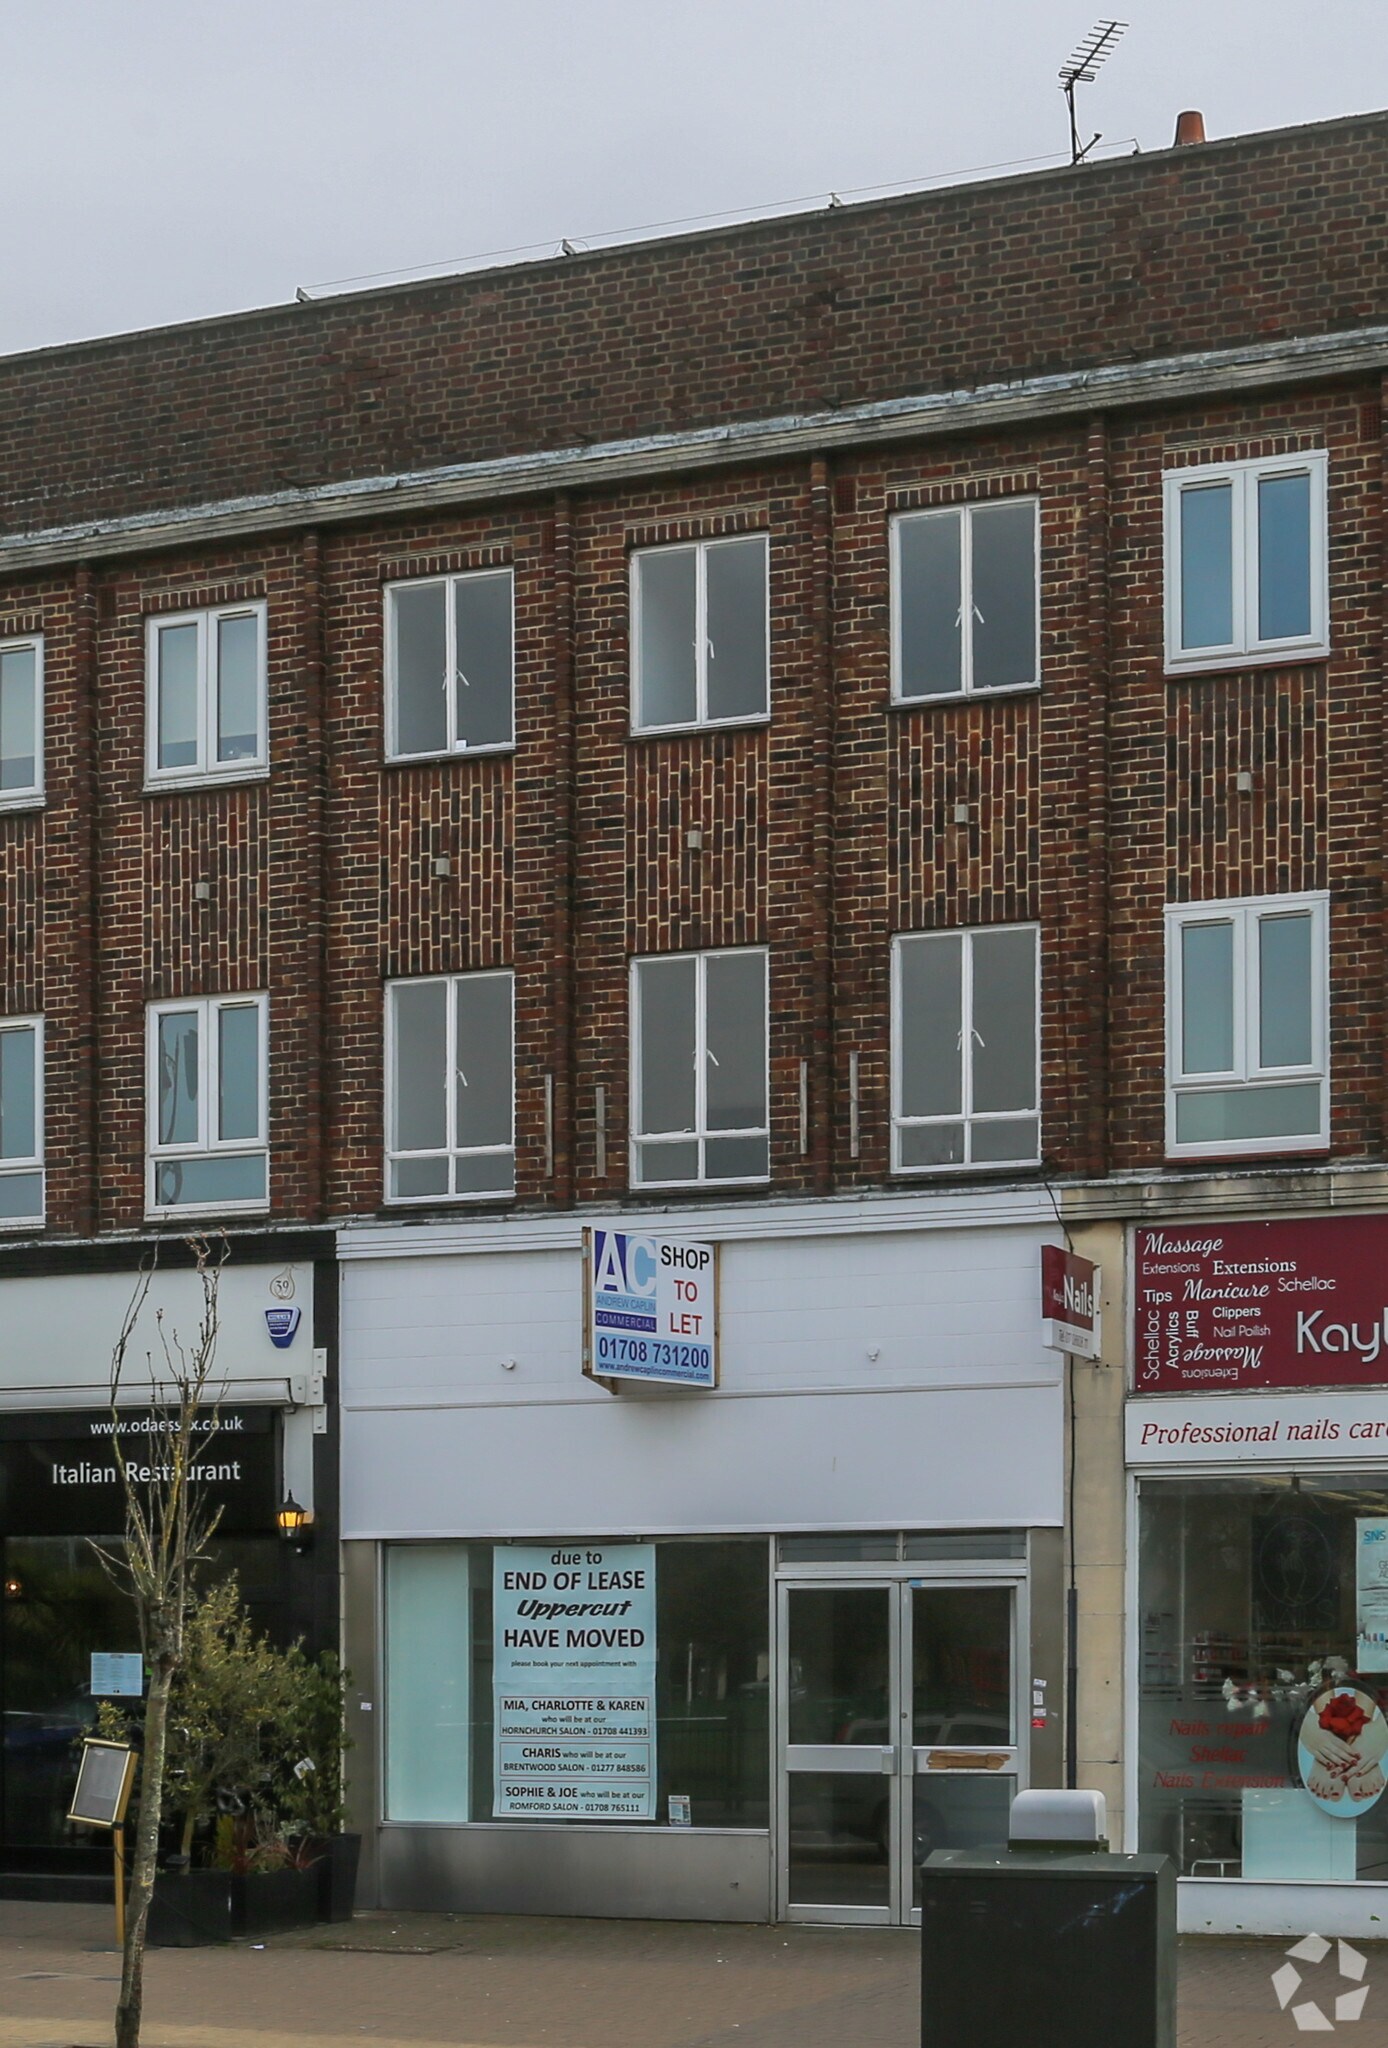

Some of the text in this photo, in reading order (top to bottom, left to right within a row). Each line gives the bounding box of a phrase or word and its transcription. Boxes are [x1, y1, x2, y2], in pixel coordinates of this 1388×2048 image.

[1143, 1233, 1223, 1257] Massage
[595, 1231, 657, 1296] AC
[661, 1245, 709, 1270] SHOP
[1143, 1259, 1296, 1275] Extensions Extensions
[674, 1280, 697, 1301] TO
[1182, 1279, 1270, 1301] Manicure
[1278, 1277, 1336, 1292] Schellac
[597, 1296, 656, 1311] ANDREW CAPLIN
[1064, 1274, 1092, 1317] Nails
[1143, 1290, 1172, 1305] Tips
[597, 1313, 656, 1330] COMMERCIAL
[1212, 1307, 1261, 1320] Clippers
[670, 1313, 702, 1335] LET
[1186, 1310, 1199, 1338] Buff
[1213, 1325, 1236, 1337] Nail
[1143, 1310, 1160, 1380] Schellac
[1166, 1311, 1182, 1368] Acrylics
[599, 1337, 709, 1369] 01708 731200
[1183, 1343, 1264, 1368] Massage
[598, 1362, 709, 1379] www.andrewcaplincommercial.com
[1182, 1368, 1238, 1380] Extensions
[91, 1416, 243, 1434] www.odaessx.co.uk
[1141, 1419, 1388, 1445] Professional nails car
[53, 1462, 116, 1484] Italian
[1364, 1530, 1386, 1541] SNS
[551, 1551, 602, 1565] due to
[504, 1571, 645, 1590] END OF LEASE
[517, 1600, 632, 1620] Uppercut
[504, 1629, 644, 1647] HAVE MOVED
[511, 1660, 531, 1668] please
[504, 1701, 645, 1712] MIA, CHARLOTTE & KAREN
[502, 1727, 557, 1735] HORNCHURCH
[1168, 1719, 1210, 1736] Nails
[522, 1748, 561, 1758] CHARIS
[504, 1763, 556, 1771] BRENTWOOD
[591, 1764, 614, 1772] 01277
[1153, 1771, 1194, 1788] Nails
[505, 1787, 544, 1797] SOPHIE
[547, 1787, 556, 1797] &
[558, 1788, 578, 1798] JOE
[510, 1802, 551, 1811] ROMFORD
[553, 1803, 578, 1811] SALON
[585, 1804, 609, 1812] 01708
[611, 1804, 640, 1812] 765111
